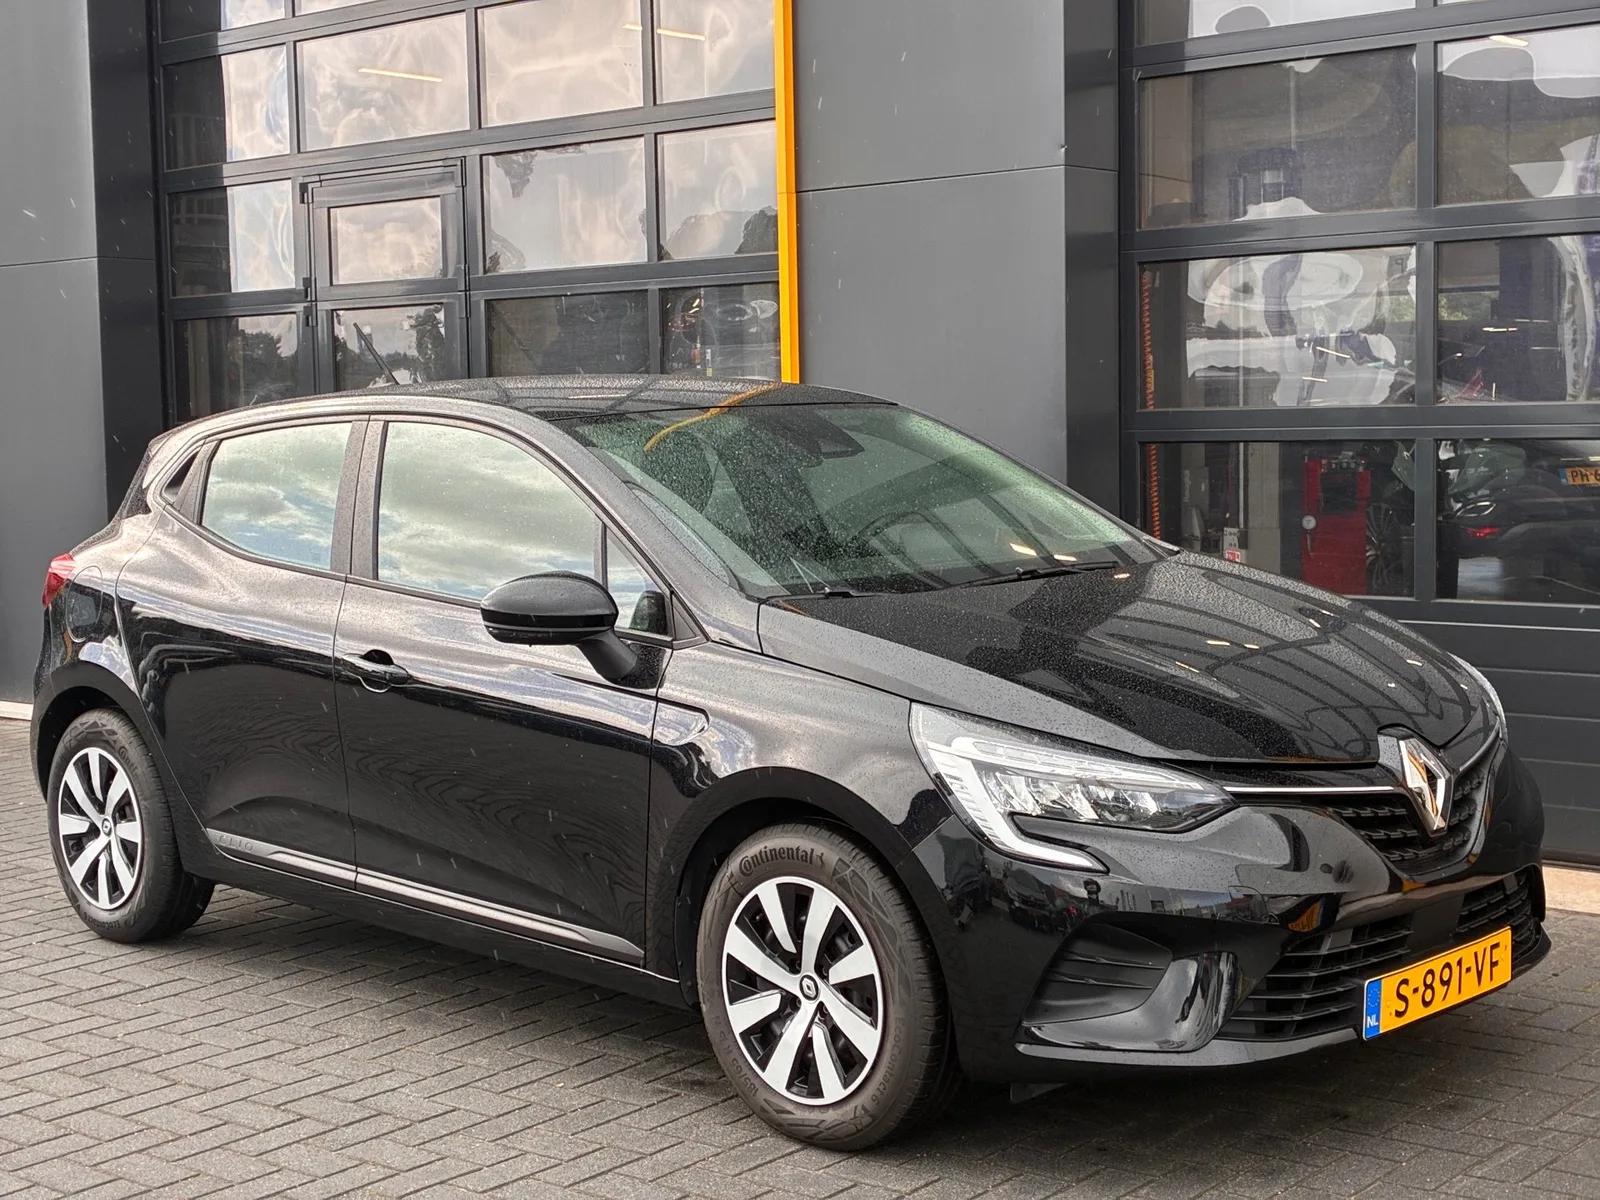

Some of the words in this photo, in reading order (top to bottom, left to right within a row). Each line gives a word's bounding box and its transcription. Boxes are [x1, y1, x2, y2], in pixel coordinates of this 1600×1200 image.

[219, 835, 253, 852] CLIO
[739, 845, 815, 877] Continental
[1394, 941, 1500, 1019] S-891-VF
[1366, 1015, 1379, 1028] NL
[875, 1016, 905, 1097] EcoContact
[731, 1059, 759, 1097] 185/65
[870, 1094, 879, 1106] 6
